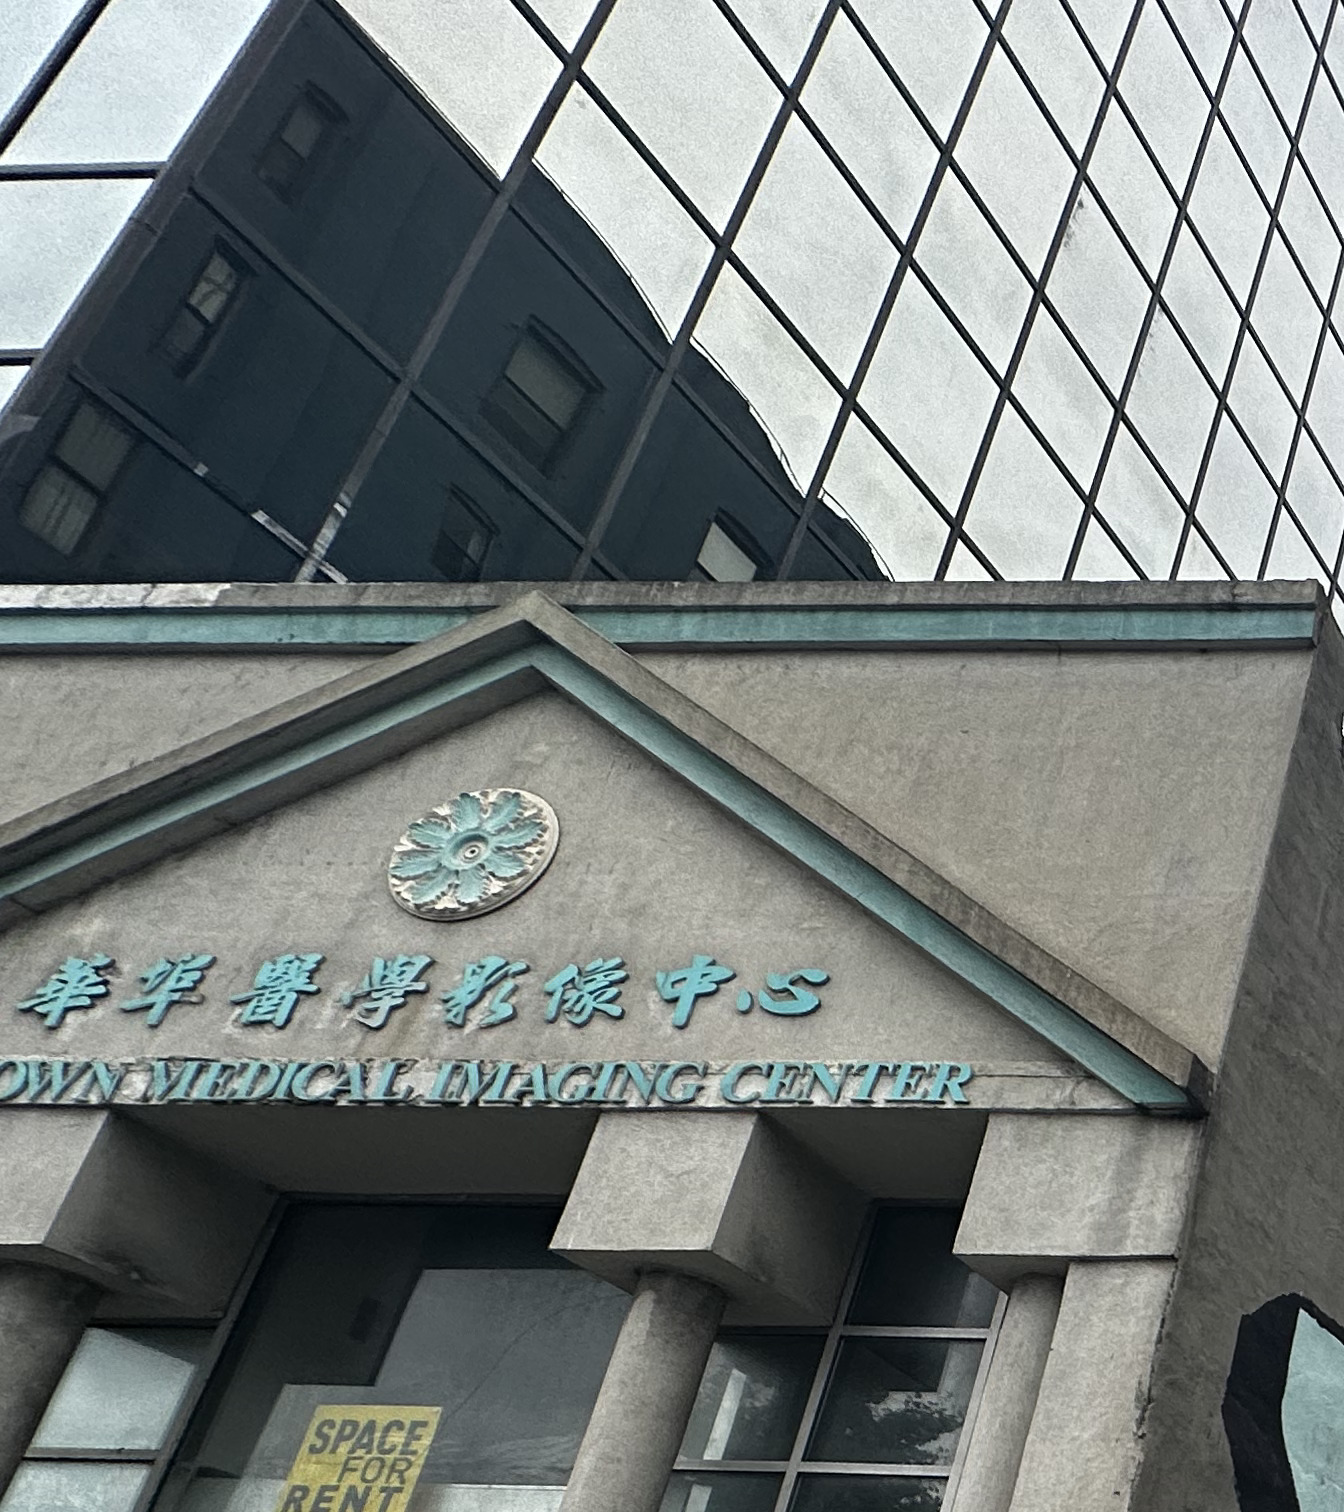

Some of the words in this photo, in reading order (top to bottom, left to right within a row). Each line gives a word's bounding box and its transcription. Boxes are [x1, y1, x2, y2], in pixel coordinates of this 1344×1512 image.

[148, 1058, 415, 1104] MEDICAL
[428, 1058, 710, 1105] IMAGING
[719, 1060, 974, 1105] CENTER
[308, 1418, 429, 1455] SPACE
[337, 1455, 413, 1484] FOR
